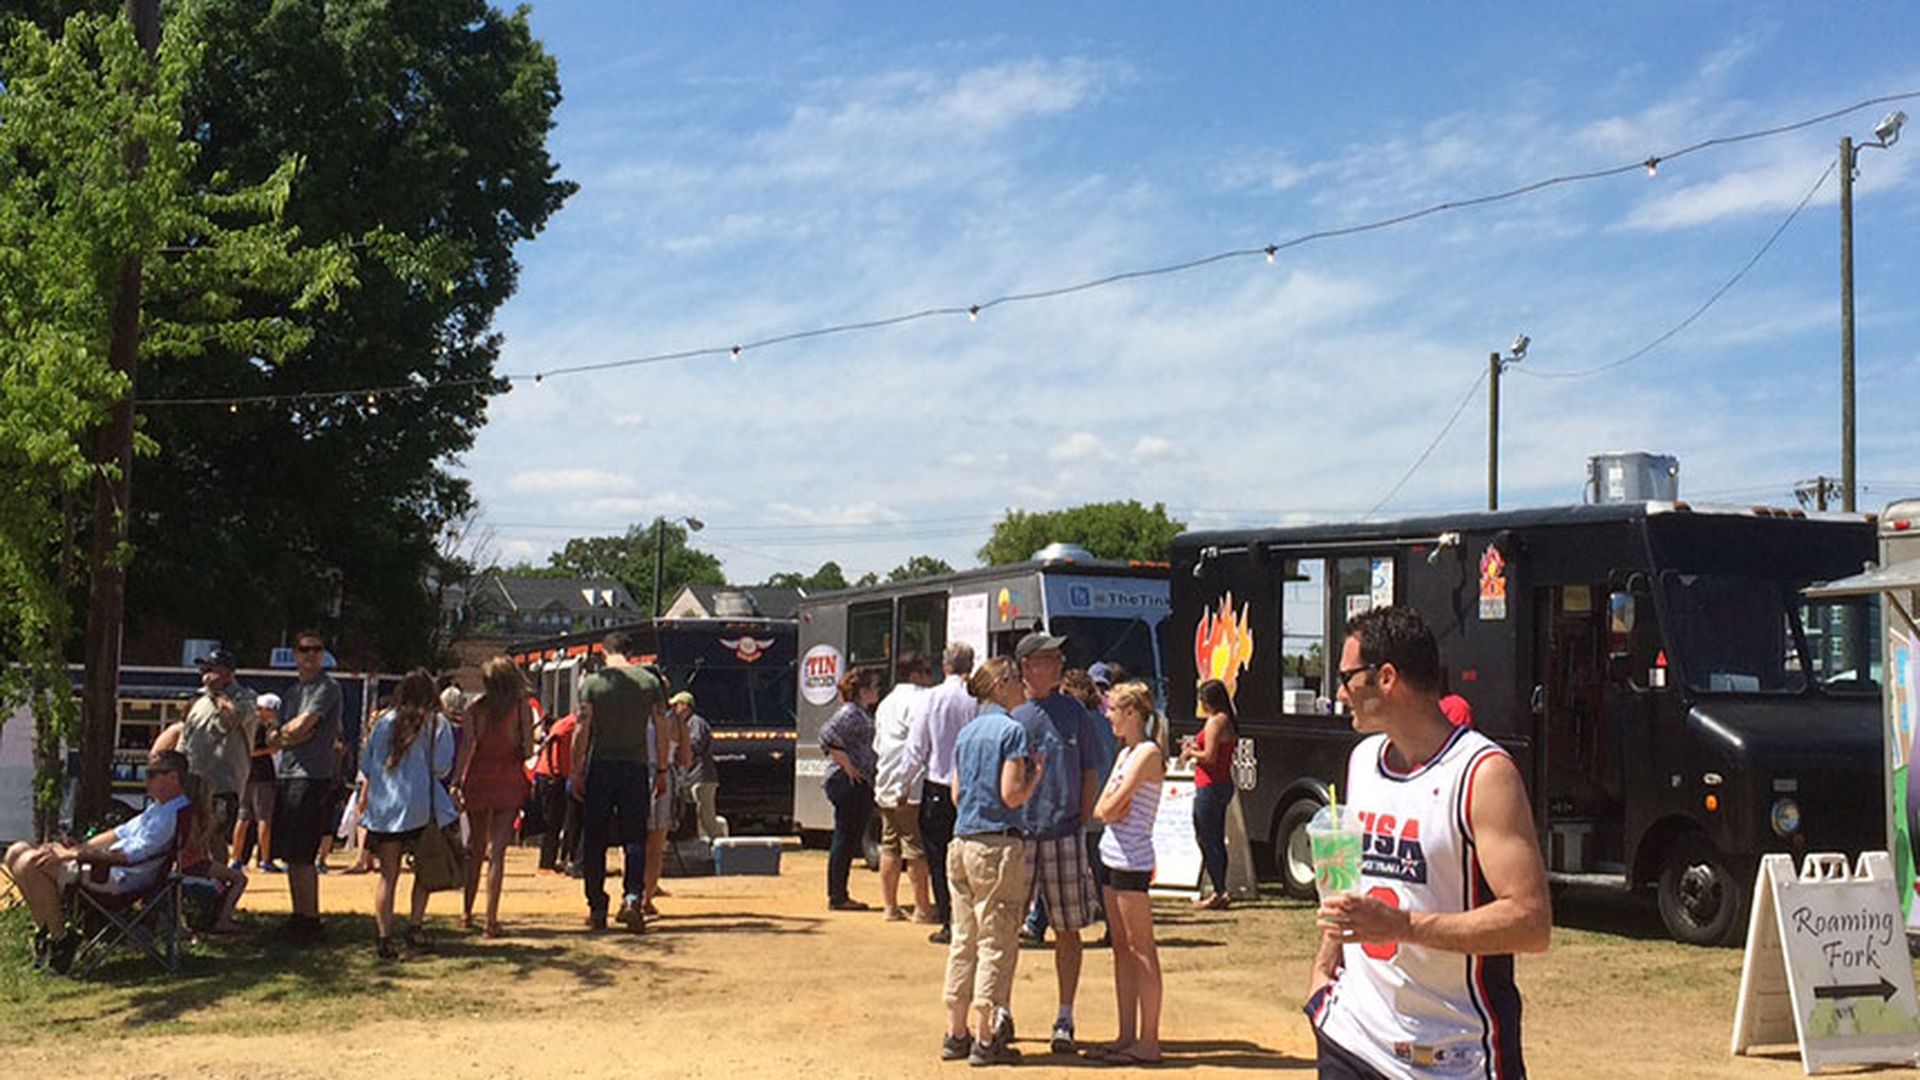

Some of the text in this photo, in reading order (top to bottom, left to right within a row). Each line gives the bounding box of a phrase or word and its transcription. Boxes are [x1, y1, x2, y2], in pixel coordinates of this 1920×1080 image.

[806, 654, 837, 675] TIN
[1792, 907, 1893, 945] Roaming
[1822, 934, 1880, 969] Fork
